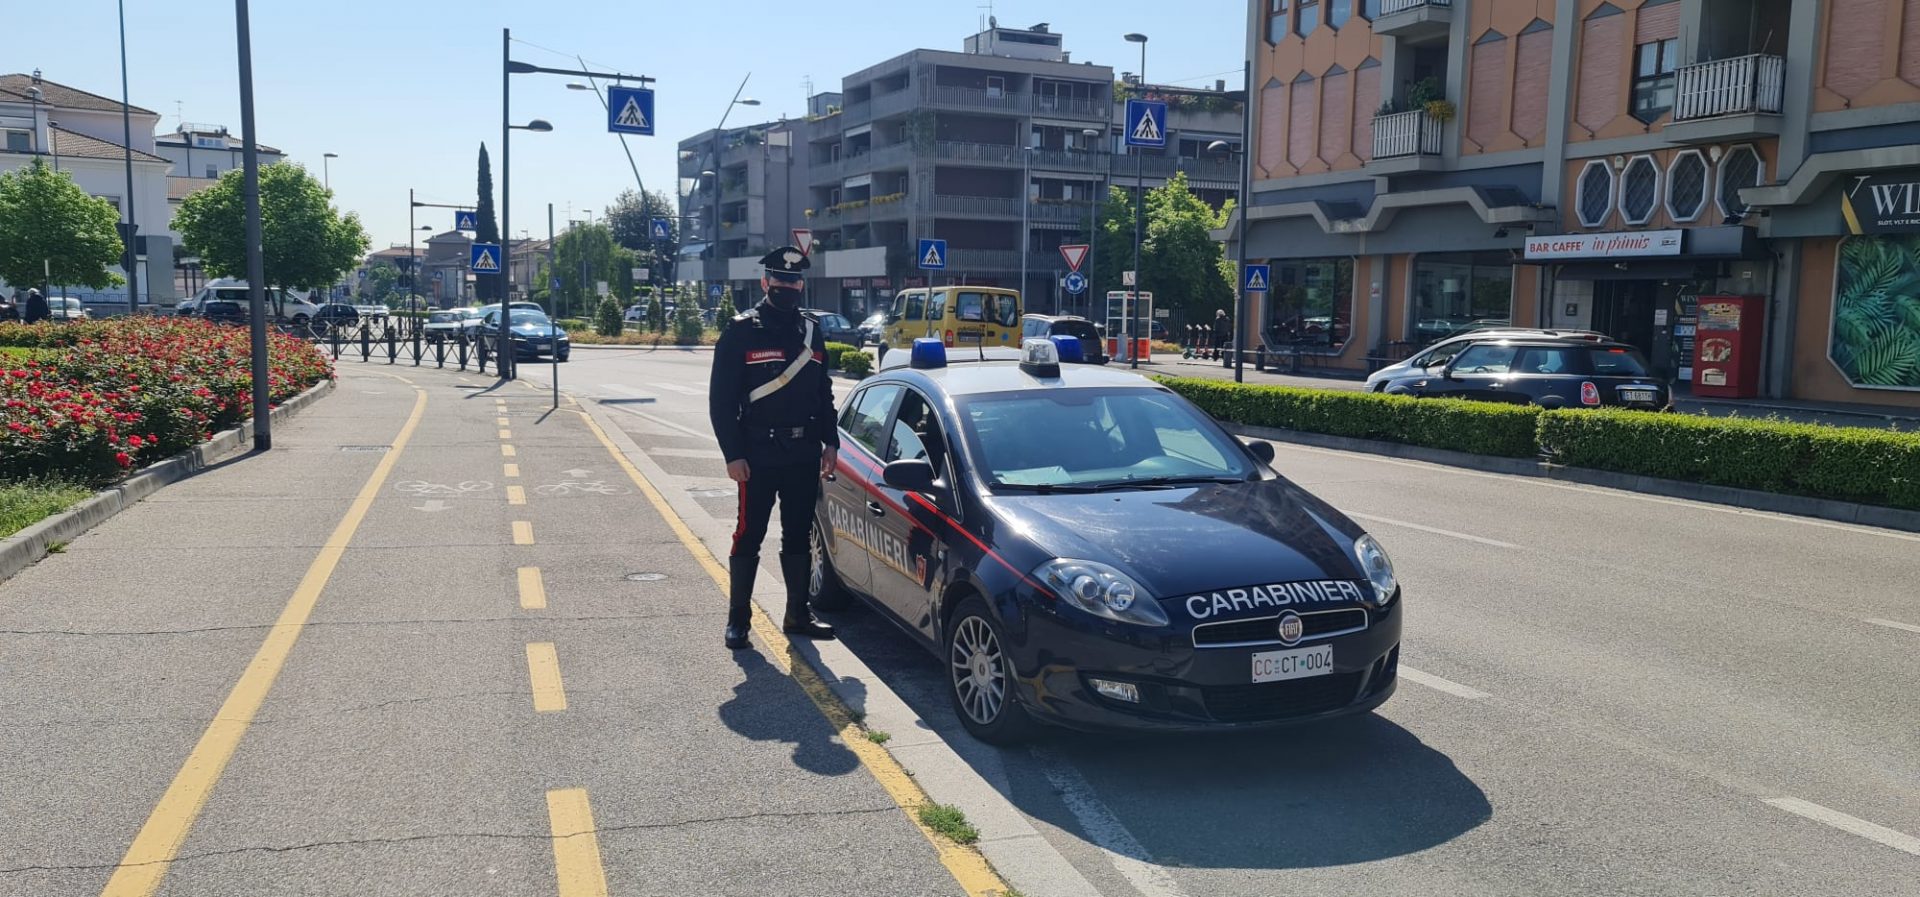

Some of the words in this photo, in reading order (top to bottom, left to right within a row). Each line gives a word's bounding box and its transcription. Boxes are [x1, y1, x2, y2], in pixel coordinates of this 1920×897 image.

[1529, 243, 1549, 253] BAR
[1552, 241, 1585, 252] CAFFE'
[1592, 237, 1605, 251] in
[1605, 234, 1650, 256] primis
[828, 499, 909, 574] CARABINIERI
[1186, 580, 1364, 619] CARABINIERI
[1284, 622, 1299, 636] FIAT
[1306, 650, 1332, 670] 004
